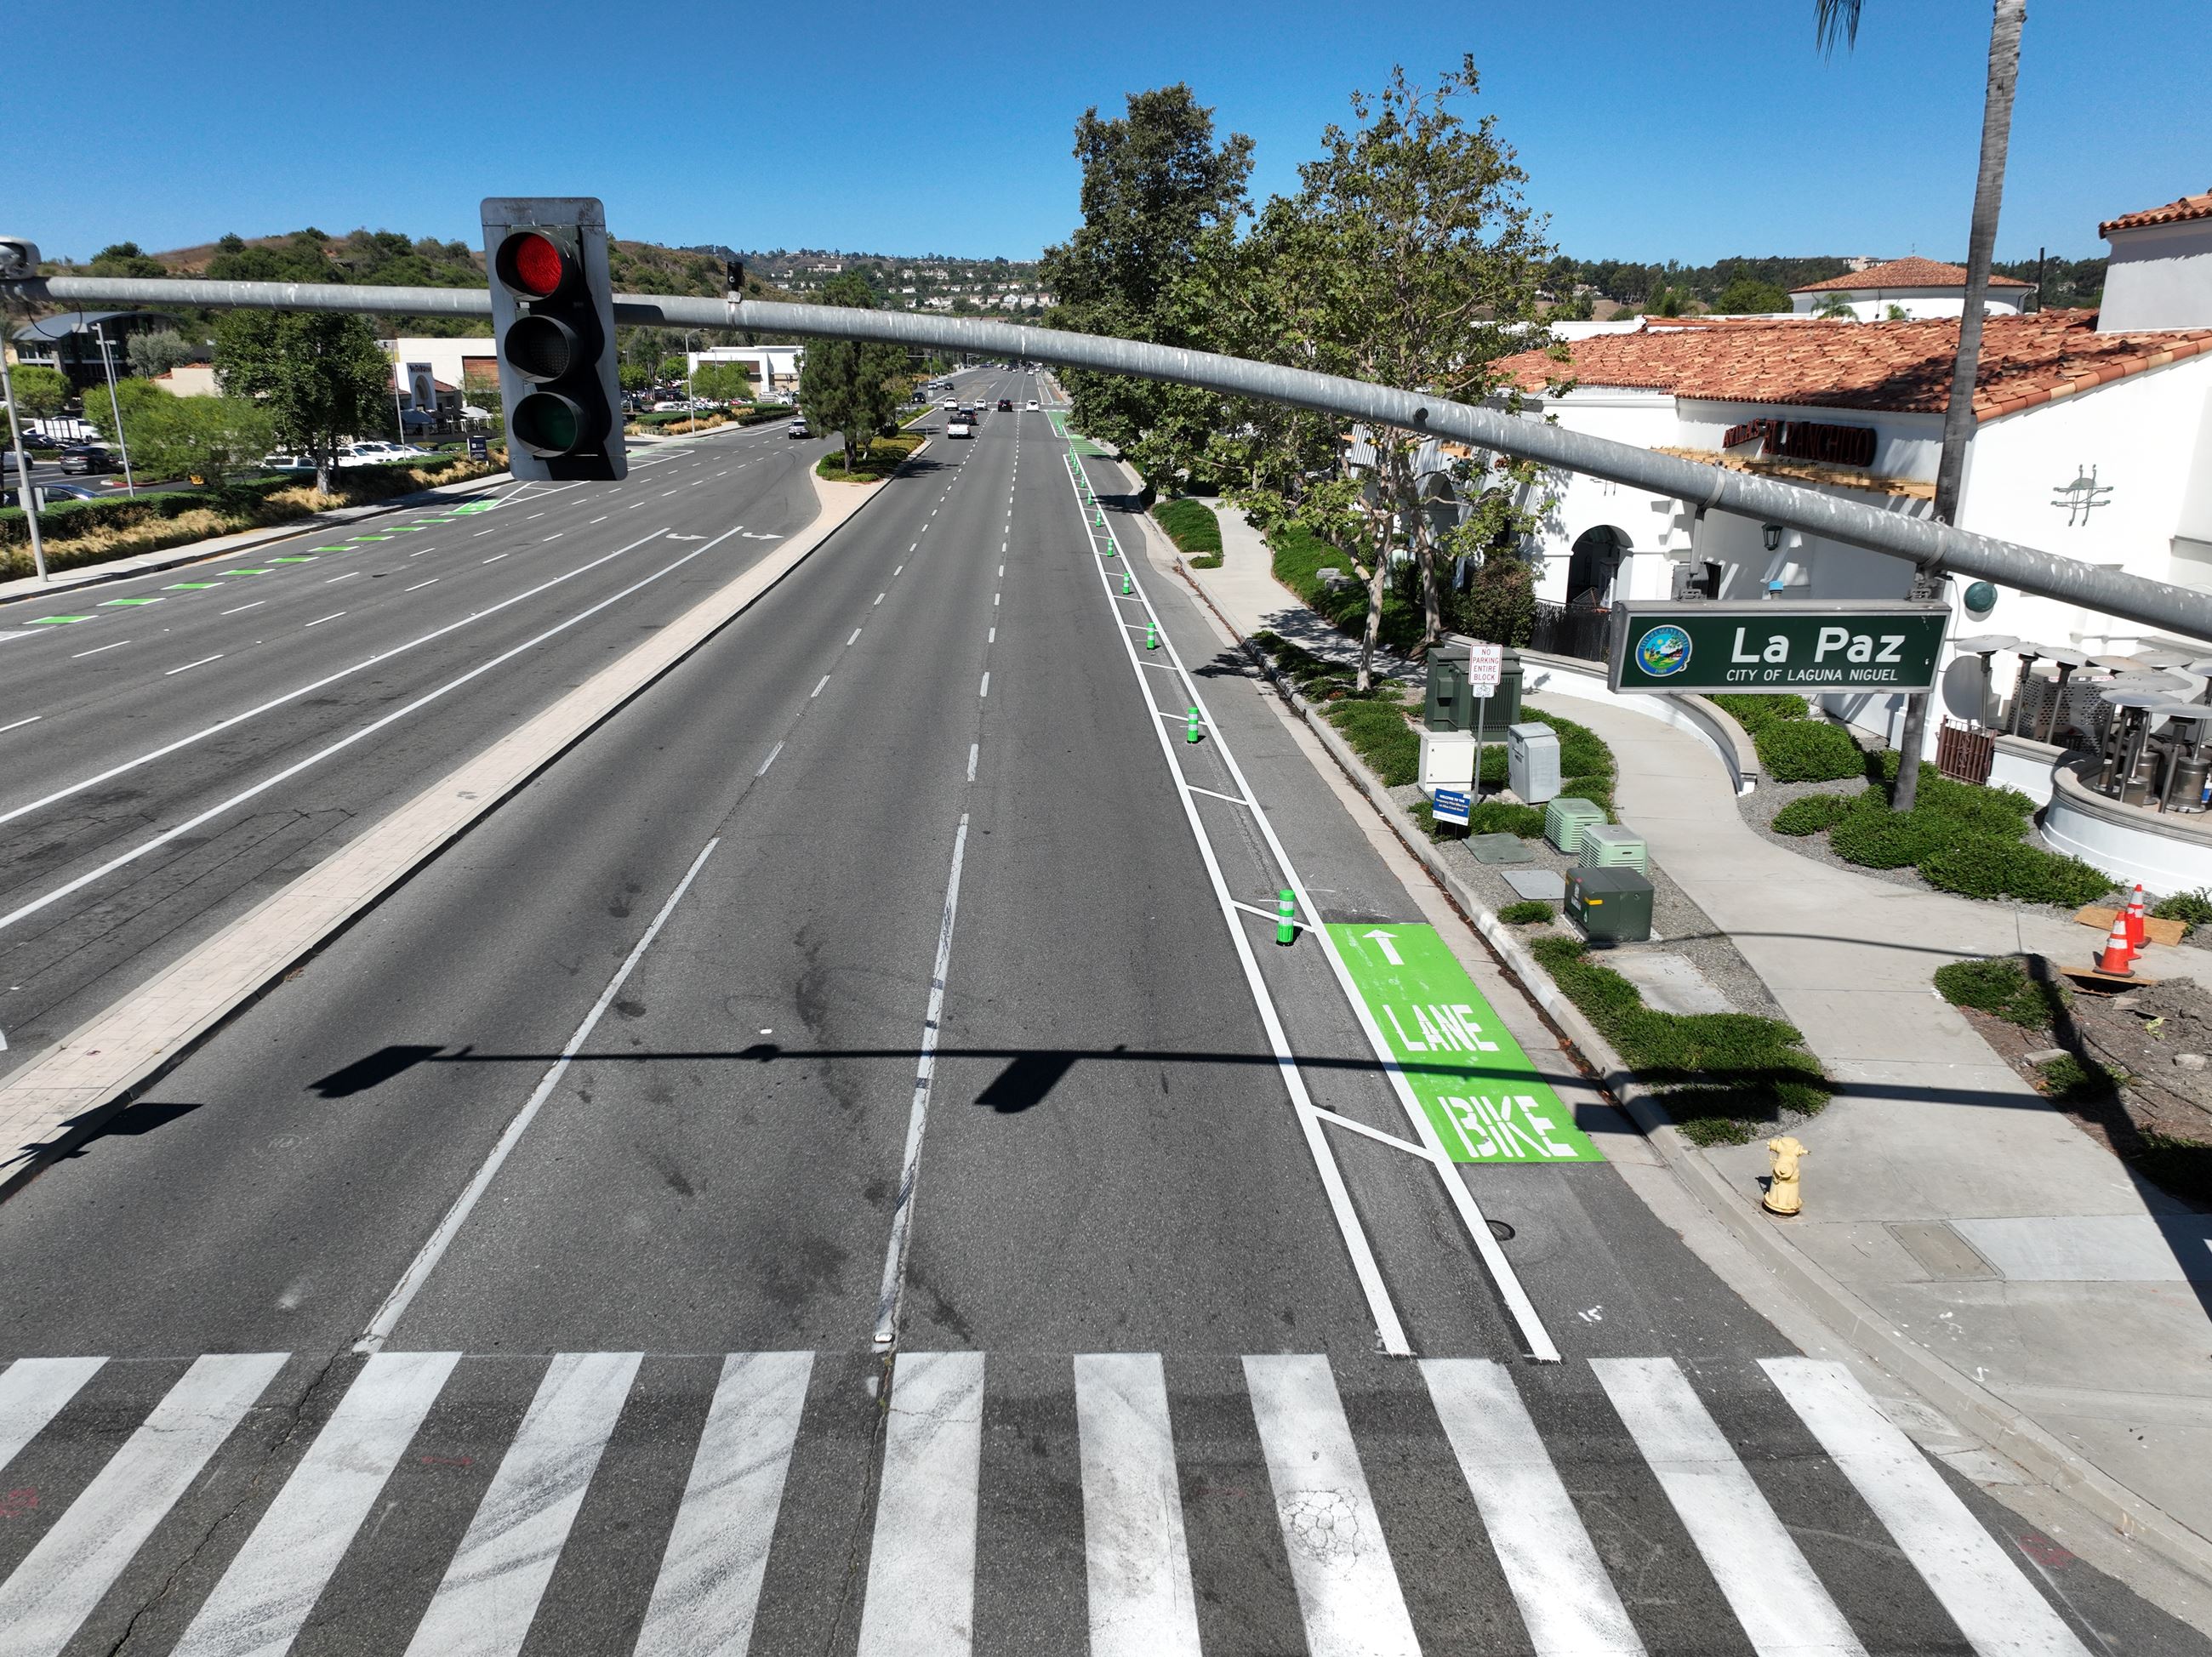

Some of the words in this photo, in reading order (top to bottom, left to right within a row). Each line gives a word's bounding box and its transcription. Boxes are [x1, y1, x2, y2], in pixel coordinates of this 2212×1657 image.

[1784, 421, 1873, 467] RANCHITO
[1730, 627, 1789, 663] La
[1814, 627, 1906, 663] Paz
[1726, 669, 1759, 681] CITY
[1764, 669, 1782, 681] OF
[1787, 669, 1843, 681] LAGUNA
[1849, 669, 1898, 680] NIGUEL
[1382, 1005, 1500, 1051] LANE
[1437, 1096, 1579, 1158] BIKE
